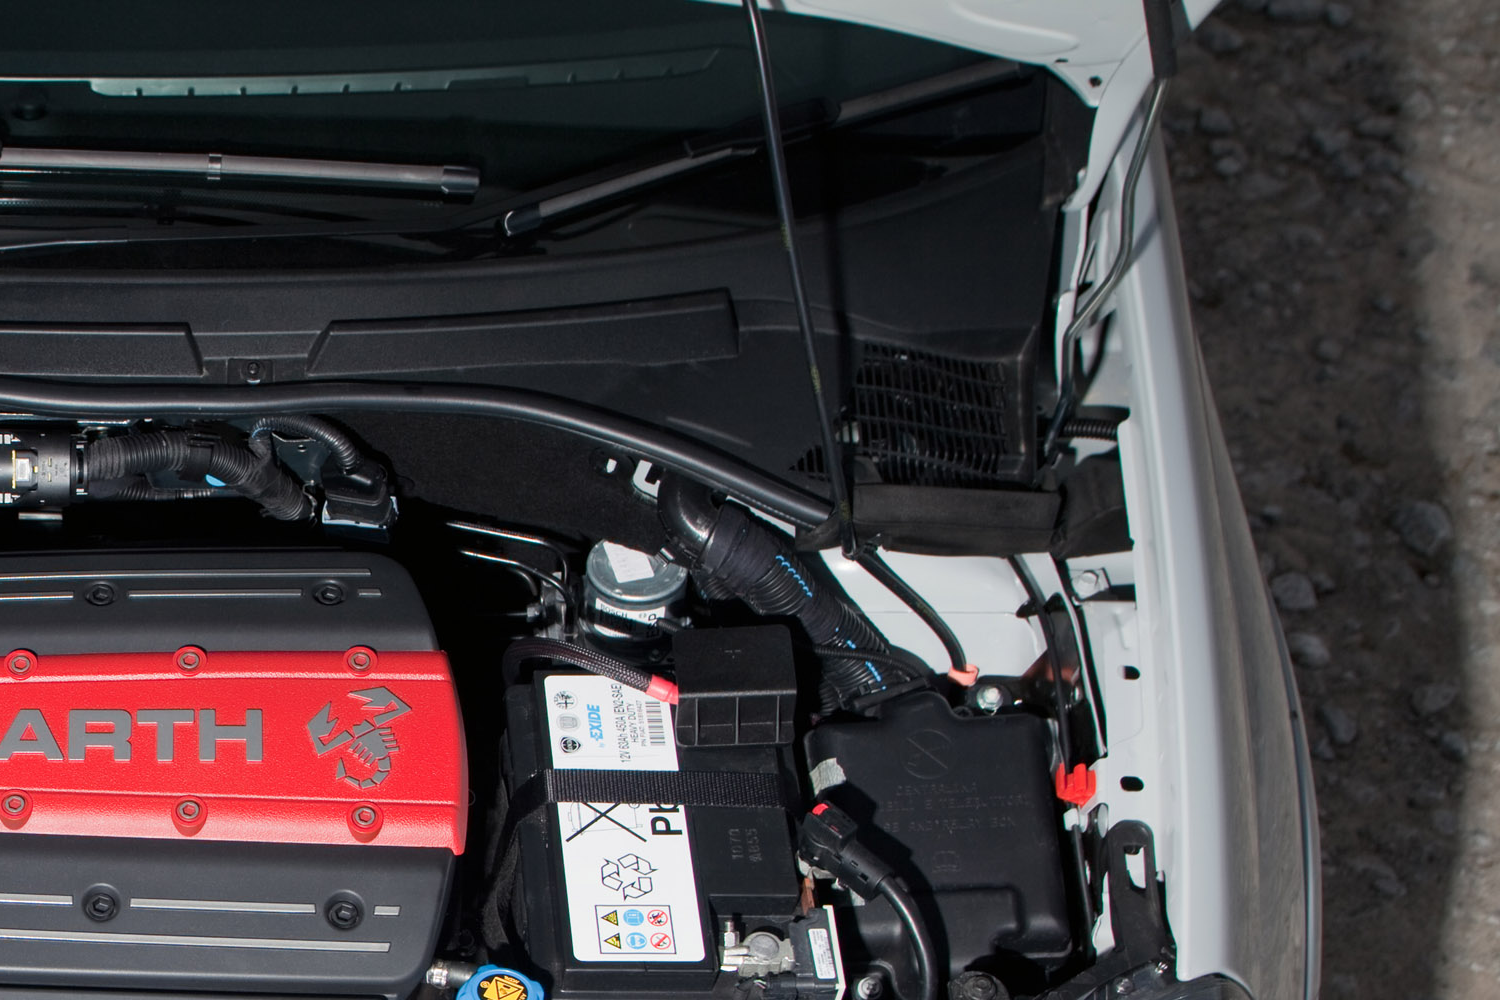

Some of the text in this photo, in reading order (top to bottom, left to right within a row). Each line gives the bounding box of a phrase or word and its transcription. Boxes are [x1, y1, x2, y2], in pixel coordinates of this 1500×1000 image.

[600, 603, 628, 618] BOSCH
[587, 704, 604, 740] EXIDE
[615, 716, 629, 732] 450A
[626, 703, 639, 743] HEAVY DUTY
[617, 733, 630, 750] 63Ah
[618, 751, 632, 763] 12V
